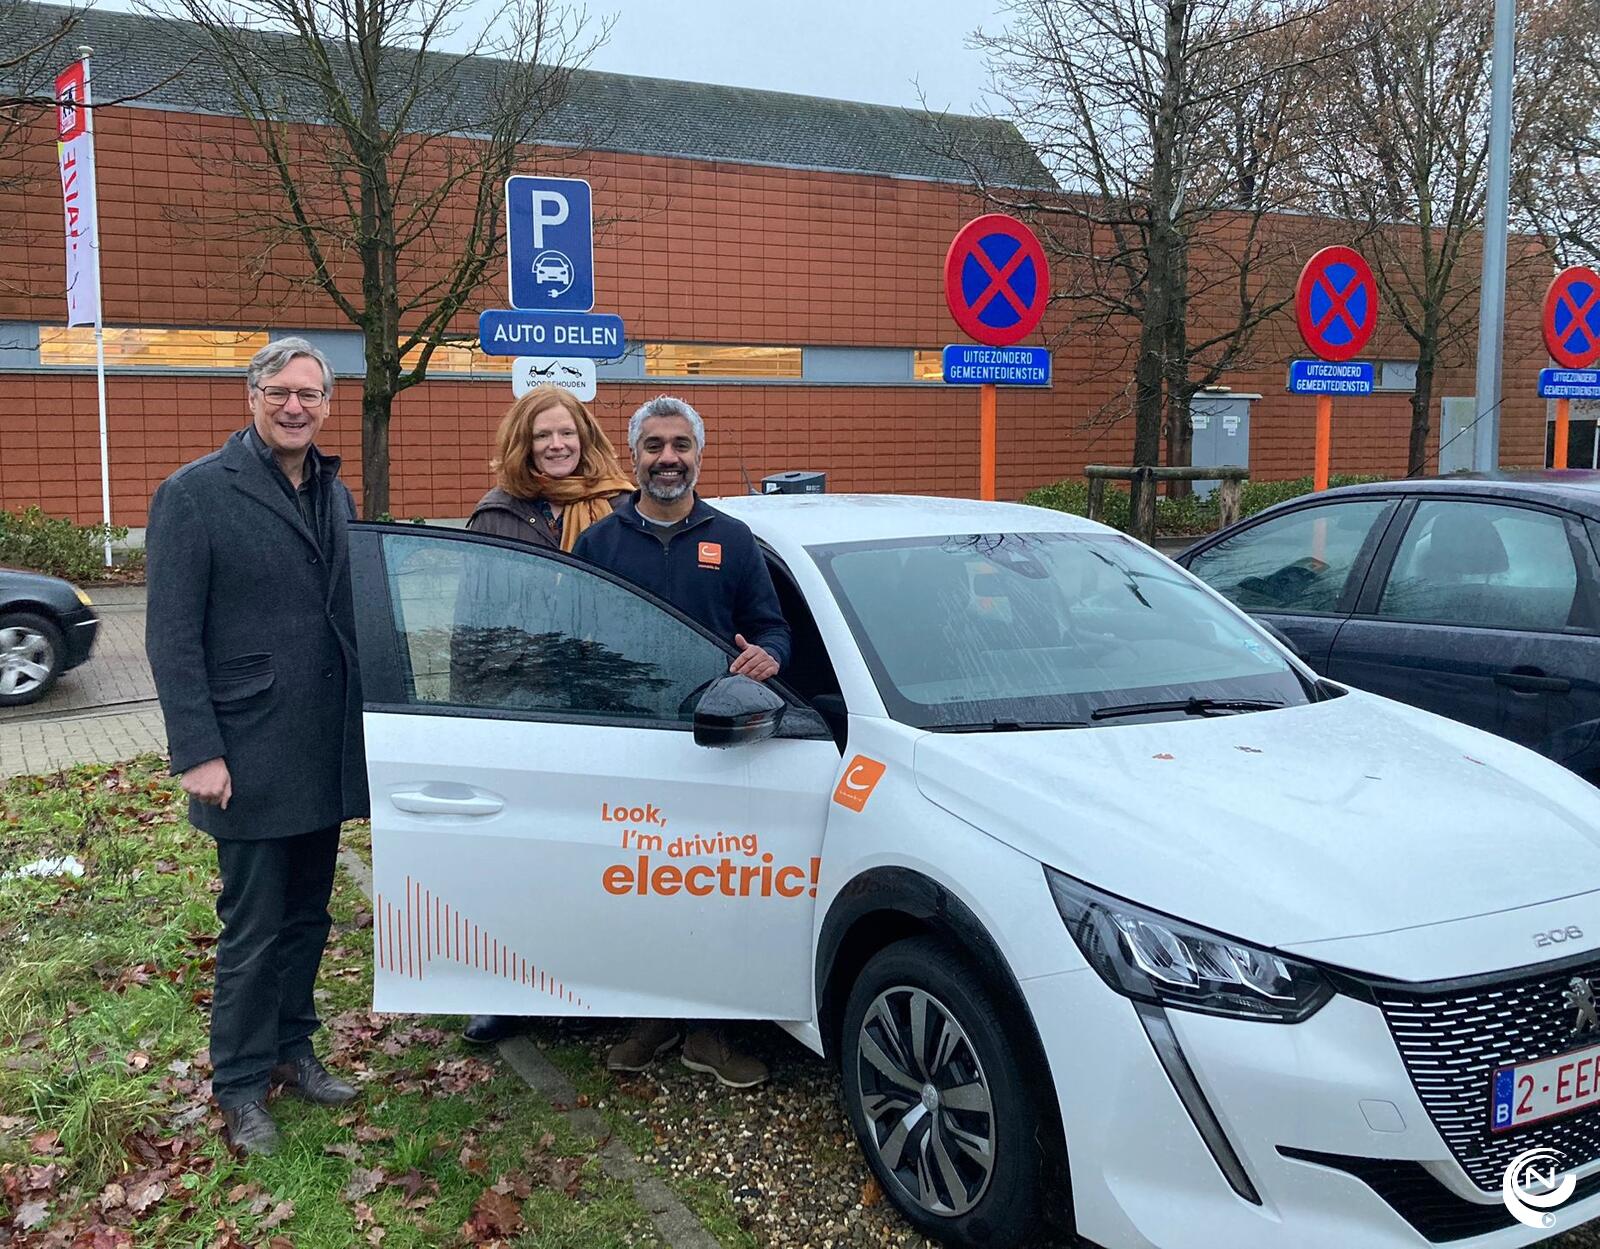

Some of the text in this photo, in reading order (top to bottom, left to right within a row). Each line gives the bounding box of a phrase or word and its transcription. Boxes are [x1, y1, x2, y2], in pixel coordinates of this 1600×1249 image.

[532, 190, 570, 248] P
[494, 323, 617, 346] AUTO DELEN
[963, 350, 1033, 364] UITGEZONDERD
[950, 366, 1045, 380] GEMEENTEDIENSTEN
[1307, 364, 1362, 377] UITGEZONDERD
[1296, 379, 1370, 392] GEMEENTEDIENSTEN
[602, 803, 667, 828] Look,
[622, 830, 758, 858] I'm driving
[602, 853, 821, 898] electric!
[1497, 1103, 1509, 1123] B
